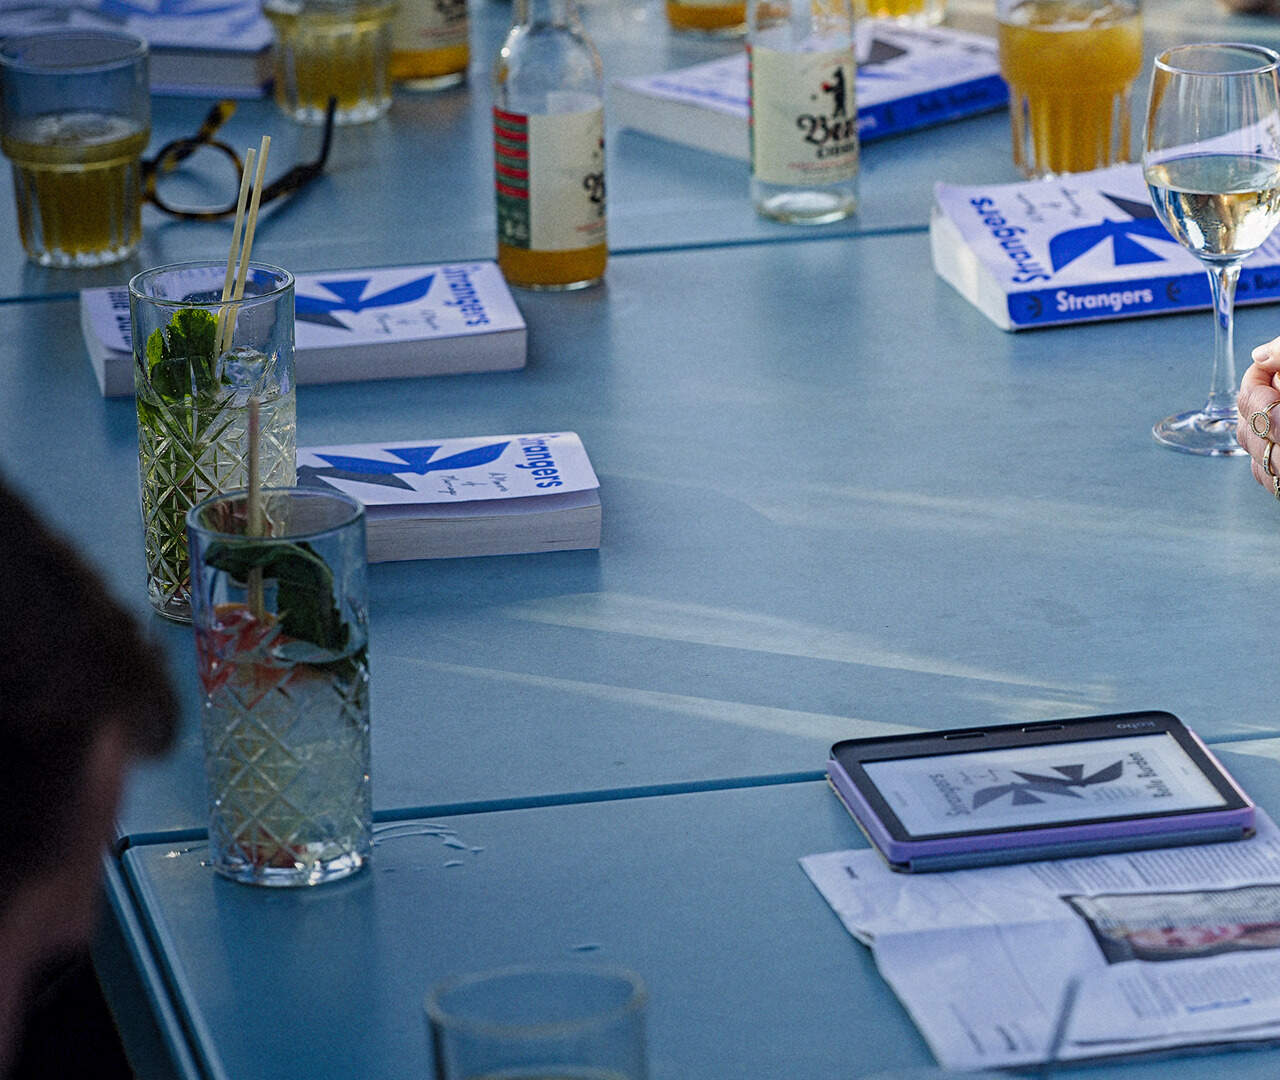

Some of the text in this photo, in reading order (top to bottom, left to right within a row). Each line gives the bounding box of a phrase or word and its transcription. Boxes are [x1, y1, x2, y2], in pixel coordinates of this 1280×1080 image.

[970, 196, 1051, 283] Strangers
[1055, 287, 1153, 313] Strangers
[515, 434, 563, 488] Strangers
